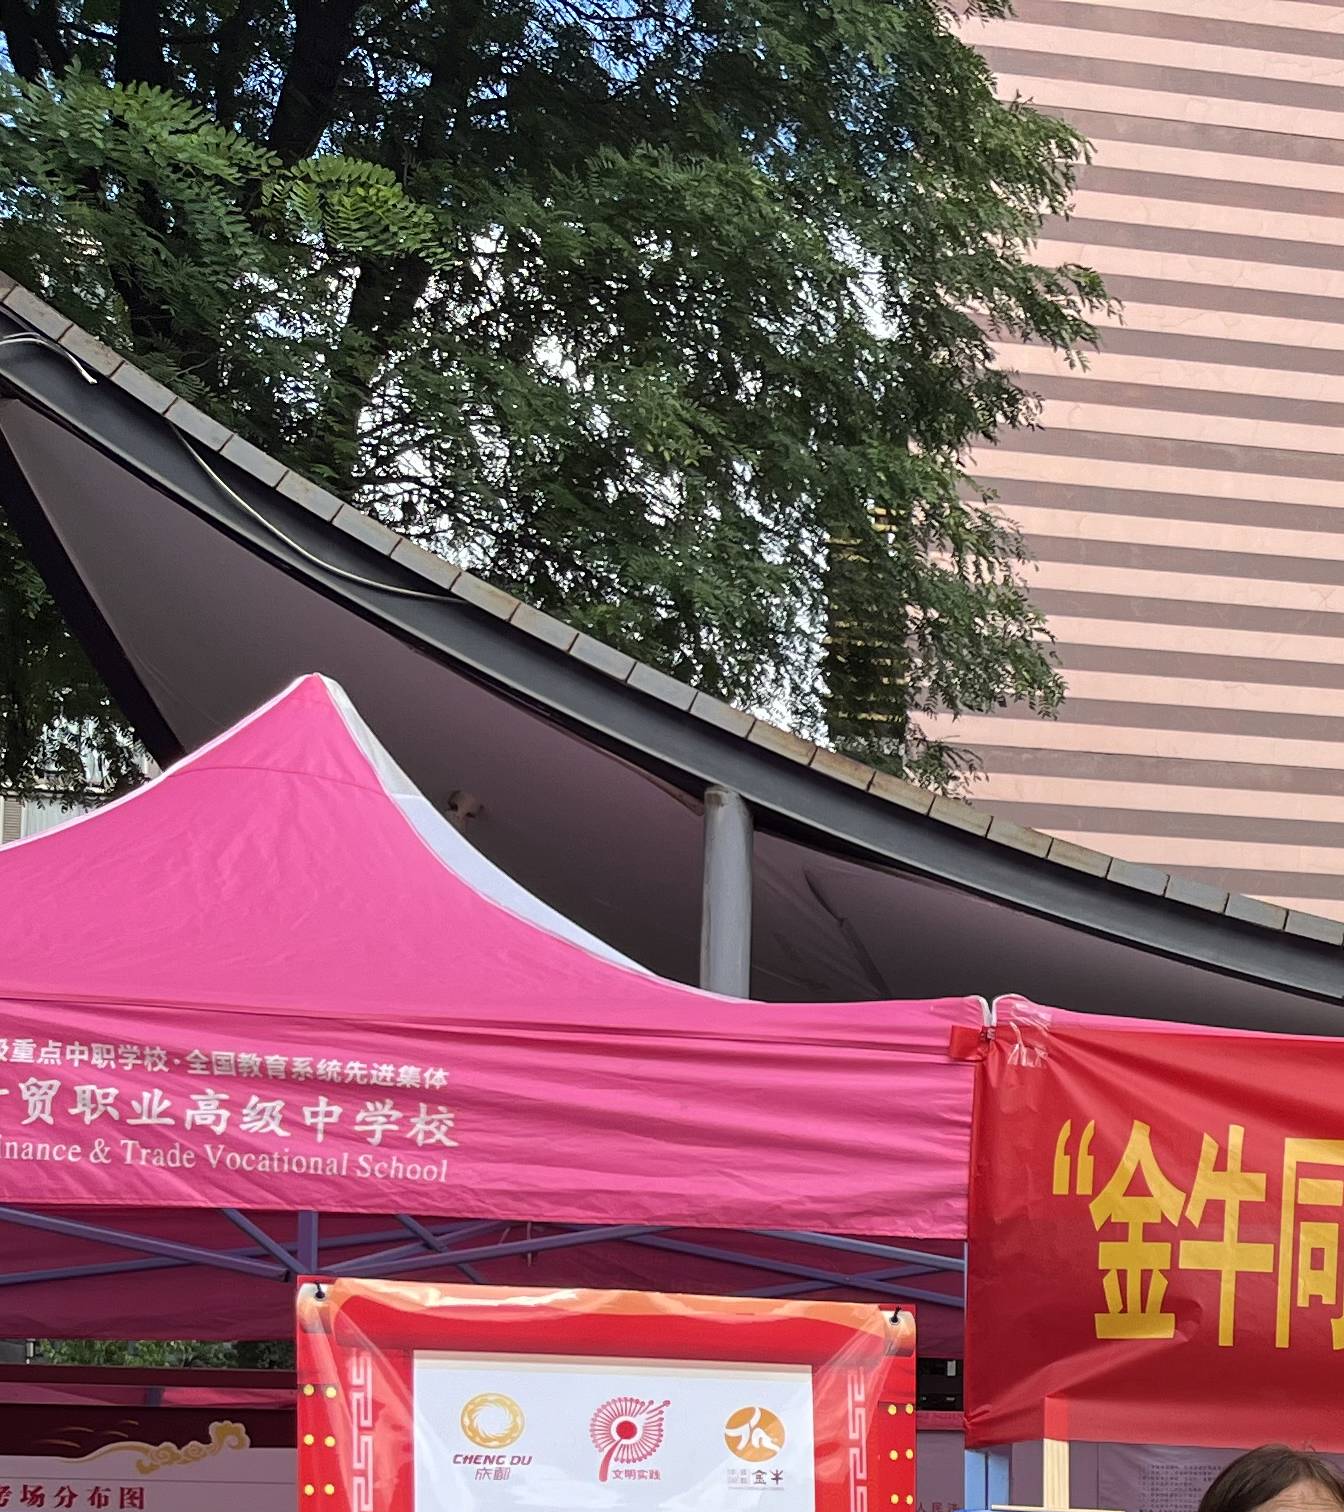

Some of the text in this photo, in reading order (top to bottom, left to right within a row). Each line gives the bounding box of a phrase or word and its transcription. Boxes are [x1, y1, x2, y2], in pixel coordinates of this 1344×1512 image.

[0, 1076, 459, 1148] 贸职业高级中学校
[89, 1138, 112, 1165] &
[121, 1139, 196, 1168] Trade
[207, 1144, 348, 1177] Vocational
[356, 1154, 448, 1183] School
[453, 1454, 533, 1467] CHENG DU
[612, 1469, 661, 1481] 文明实践
